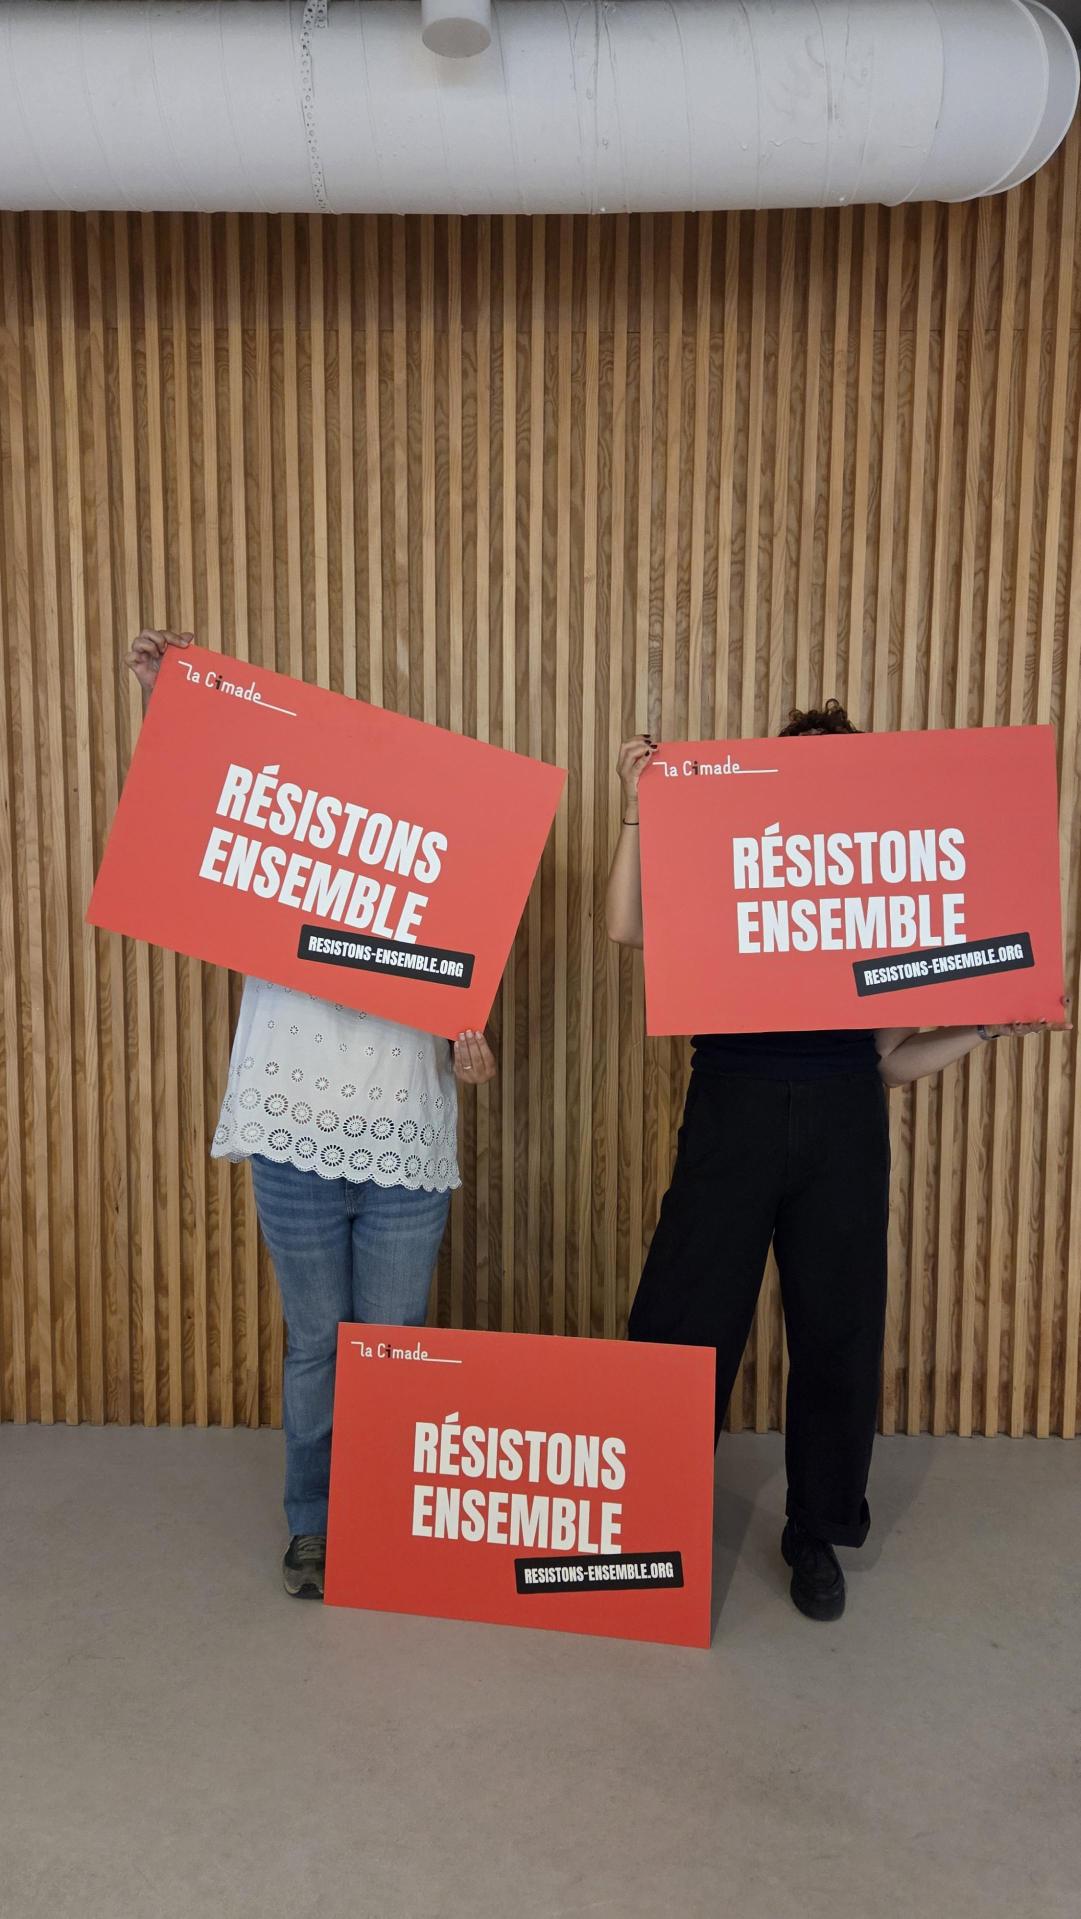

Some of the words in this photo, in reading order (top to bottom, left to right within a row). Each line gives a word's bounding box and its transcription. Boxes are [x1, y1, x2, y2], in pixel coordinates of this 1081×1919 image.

[179, 661, 200, 683] la
[652, 762, 678, 777] la
[683, 755, 779, 776] Cimade
[216, 764, 447, 883] RÉSISTONS
[733, 822, 965, 889] RÉSISTONS
[199, 827, 428, 944] ENSEMBLE
[737, 893, 966, 953] ENSEMBLE
[308, 935, 464, 977] RESISTONS-ENSEMBLE.ORG
[863, 943, 1024, 985] RESISTONS-ENSEMBLE.ORG
[350, 1342, 372, 1357] la
[377, 1343, 462, 1364] Cimade
[414, 1412, 625, 1490] RÉSISTONS
[413, 1485, 621, 1554] ENSEMBLE
[524, 1562, 674, 1583] RESISTONS-ENSEMBLE.ORG
